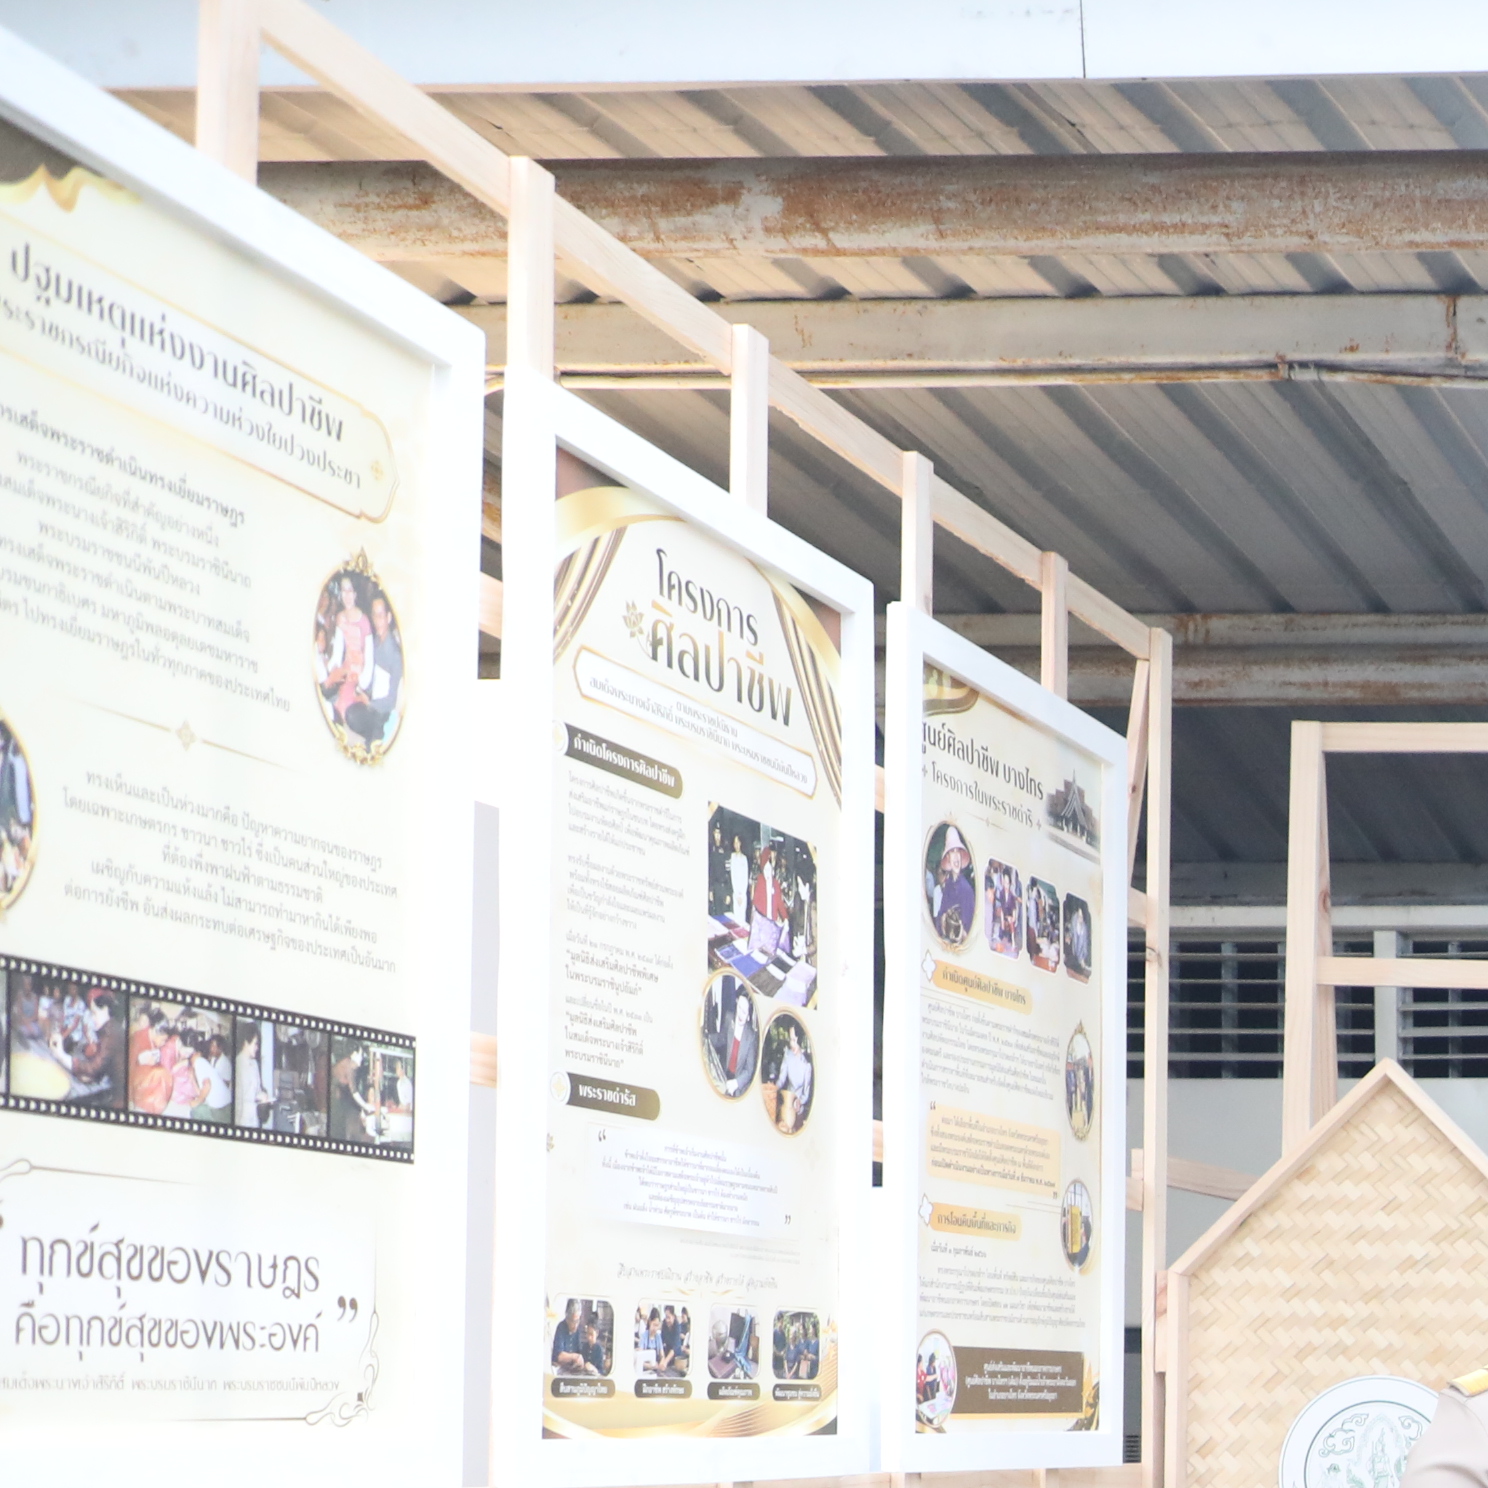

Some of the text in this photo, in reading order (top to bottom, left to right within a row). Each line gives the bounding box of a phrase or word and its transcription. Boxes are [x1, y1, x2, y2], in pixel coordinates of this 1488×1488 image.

[9, 241, 343, 442] ปฐมเหตุแห่งงานศิลปาชีพ
[0, 294, 361, 489] ระราชกรณียกิจแห่งความห่วงใยปวงประชา
[0, 402, 245, 529] ารเสด็จพระราชดำเนินทรงเยี่ยมราษฎร
[0, 472, 147, 545] สมเด็จพระนางเจ้าสิริกิติ์
[656, 548, 759, 647] โครงการ
[650, 599, 793, 728] ศิลปาชีพ
[573, 731, 676, 789] กำเนิดโครงการศิลปาชีพ
[931, 760, 1034, 830] โครงการในพระราชดำริ
[1002, 761, 1044, 801] บางไทร
[577, 1081, 637, 1108] พระราชดำรัส
[20, 1221, 320, 1300] ทุกข์สุขของราษฎร
[14, 1298, 322, 1363] คือทุกข์สุขของพระองค์
